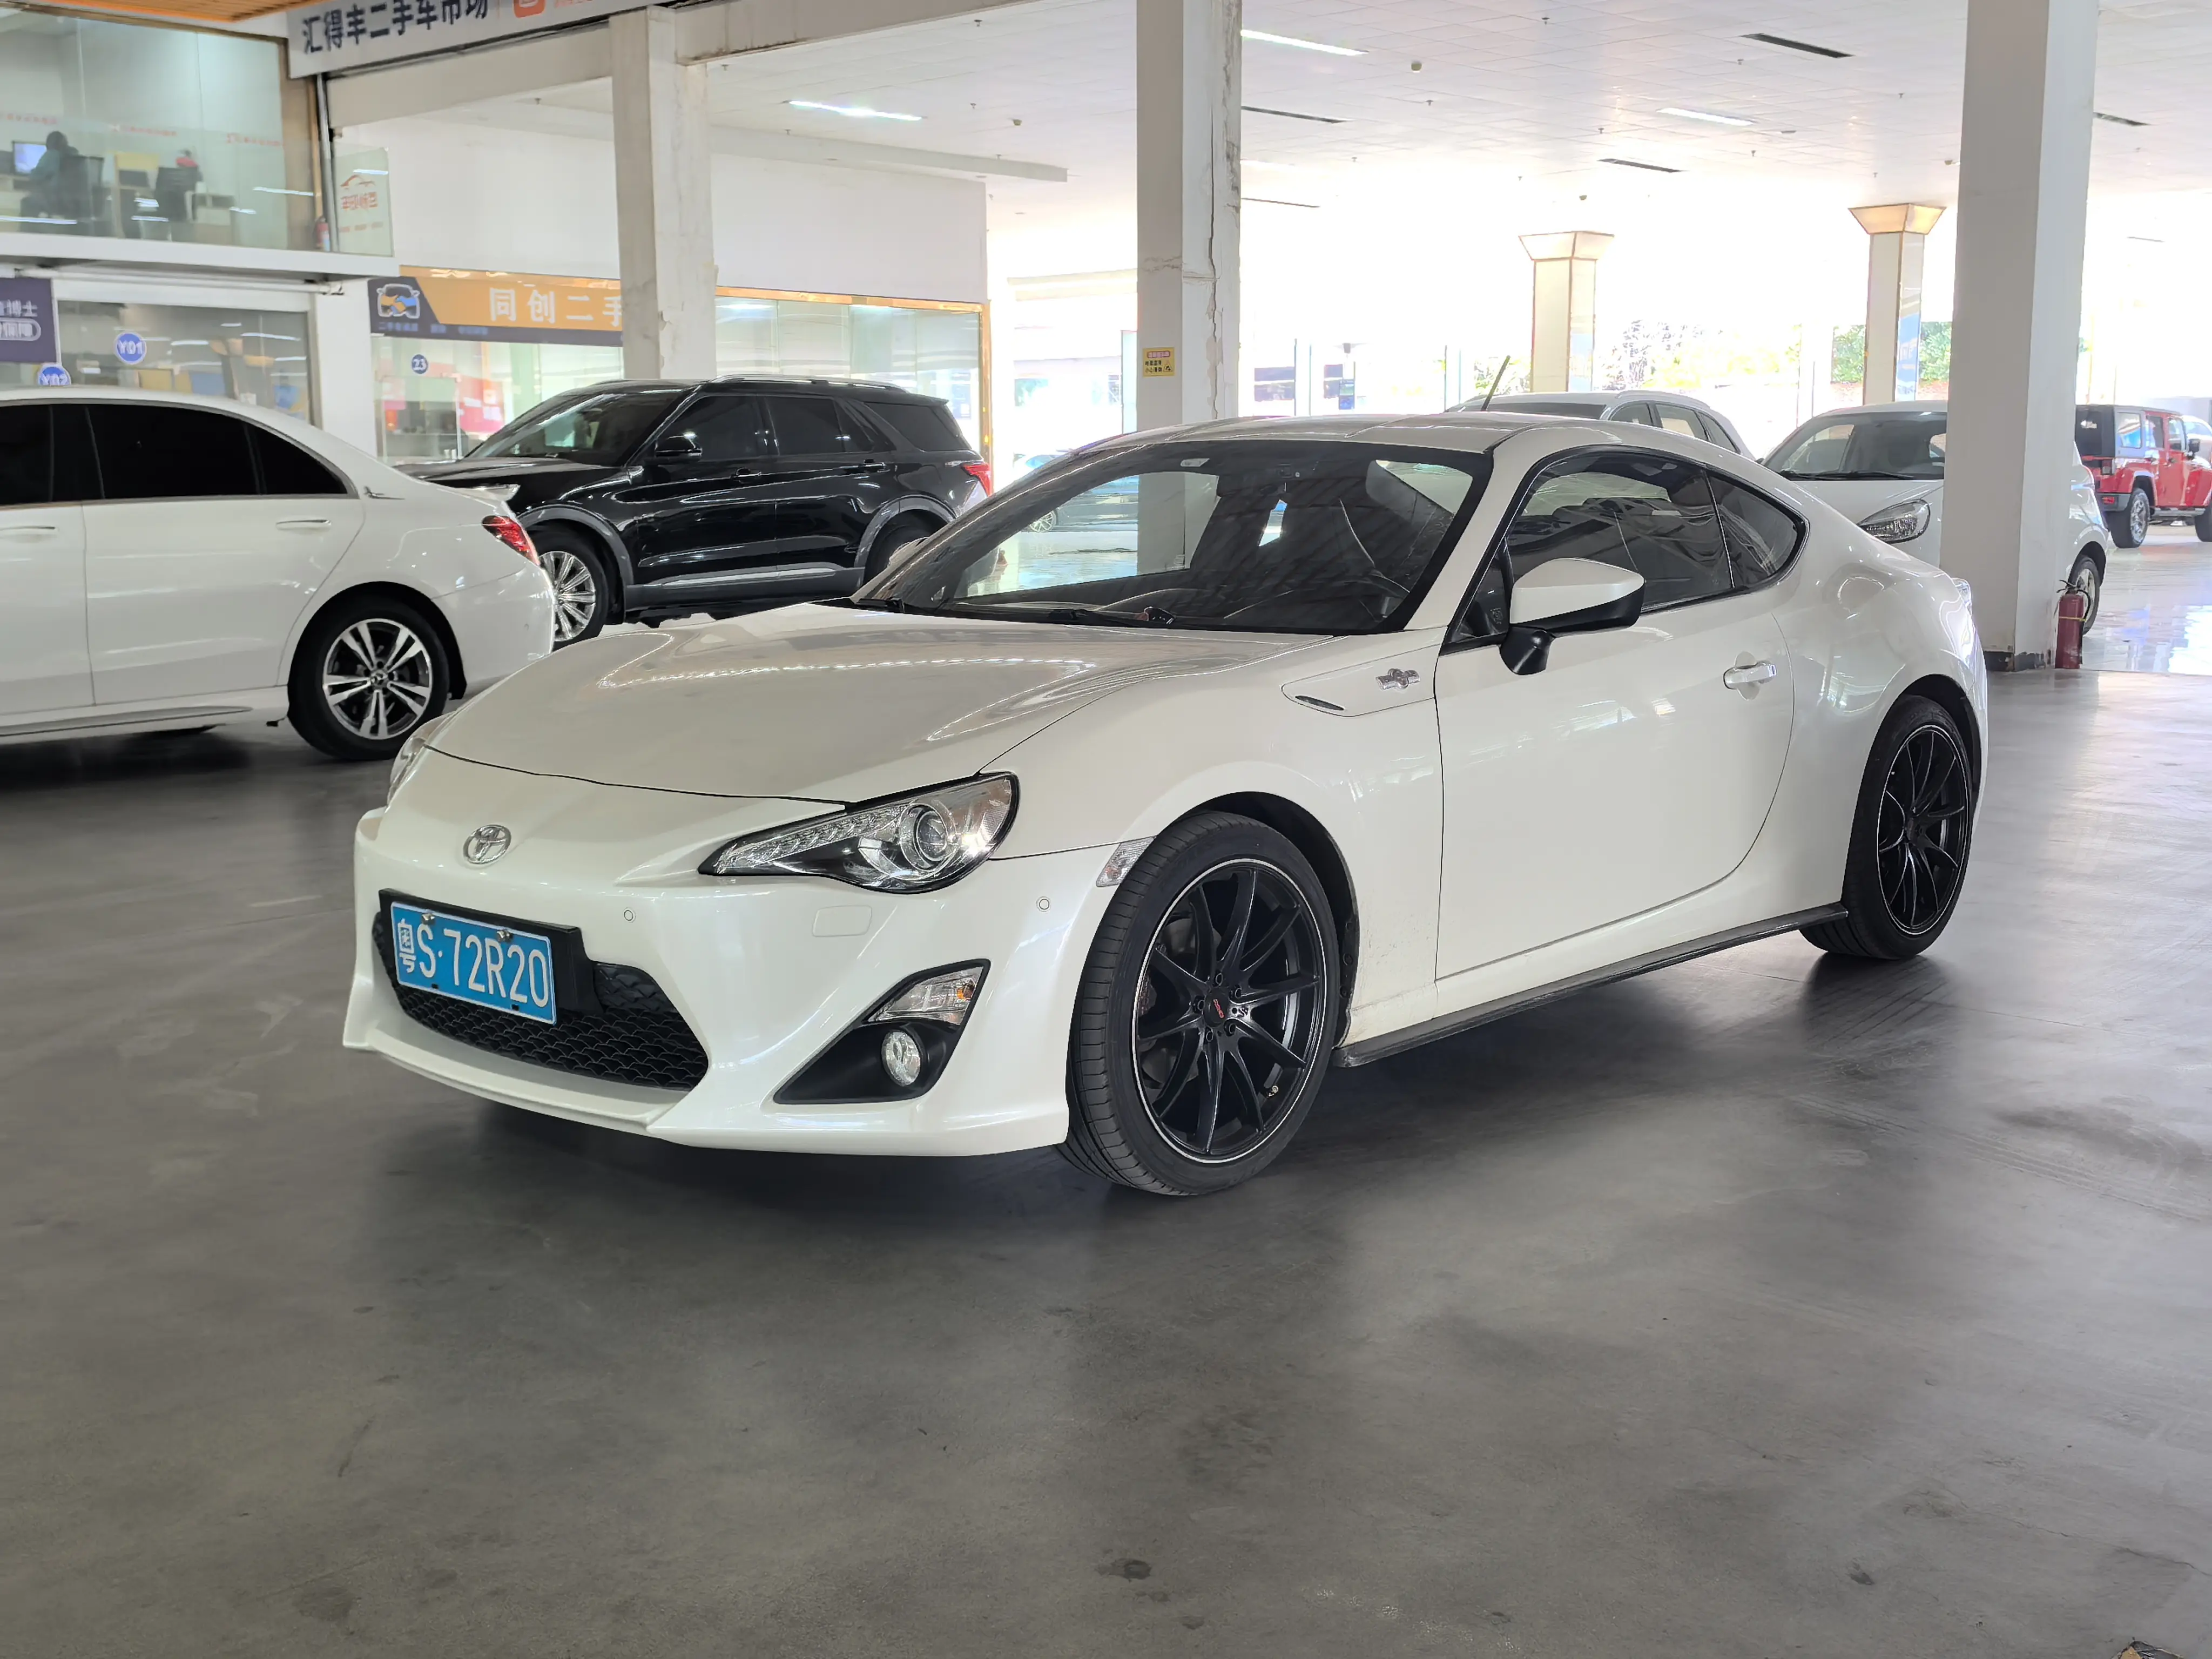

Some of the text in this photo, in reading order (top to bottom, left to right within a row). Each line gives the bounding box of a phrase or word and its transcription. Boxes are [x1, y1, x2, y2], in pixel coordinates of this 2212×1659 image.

[489, 287, 622, 327] 同创二手
[413, 358, 427, 370] 23
